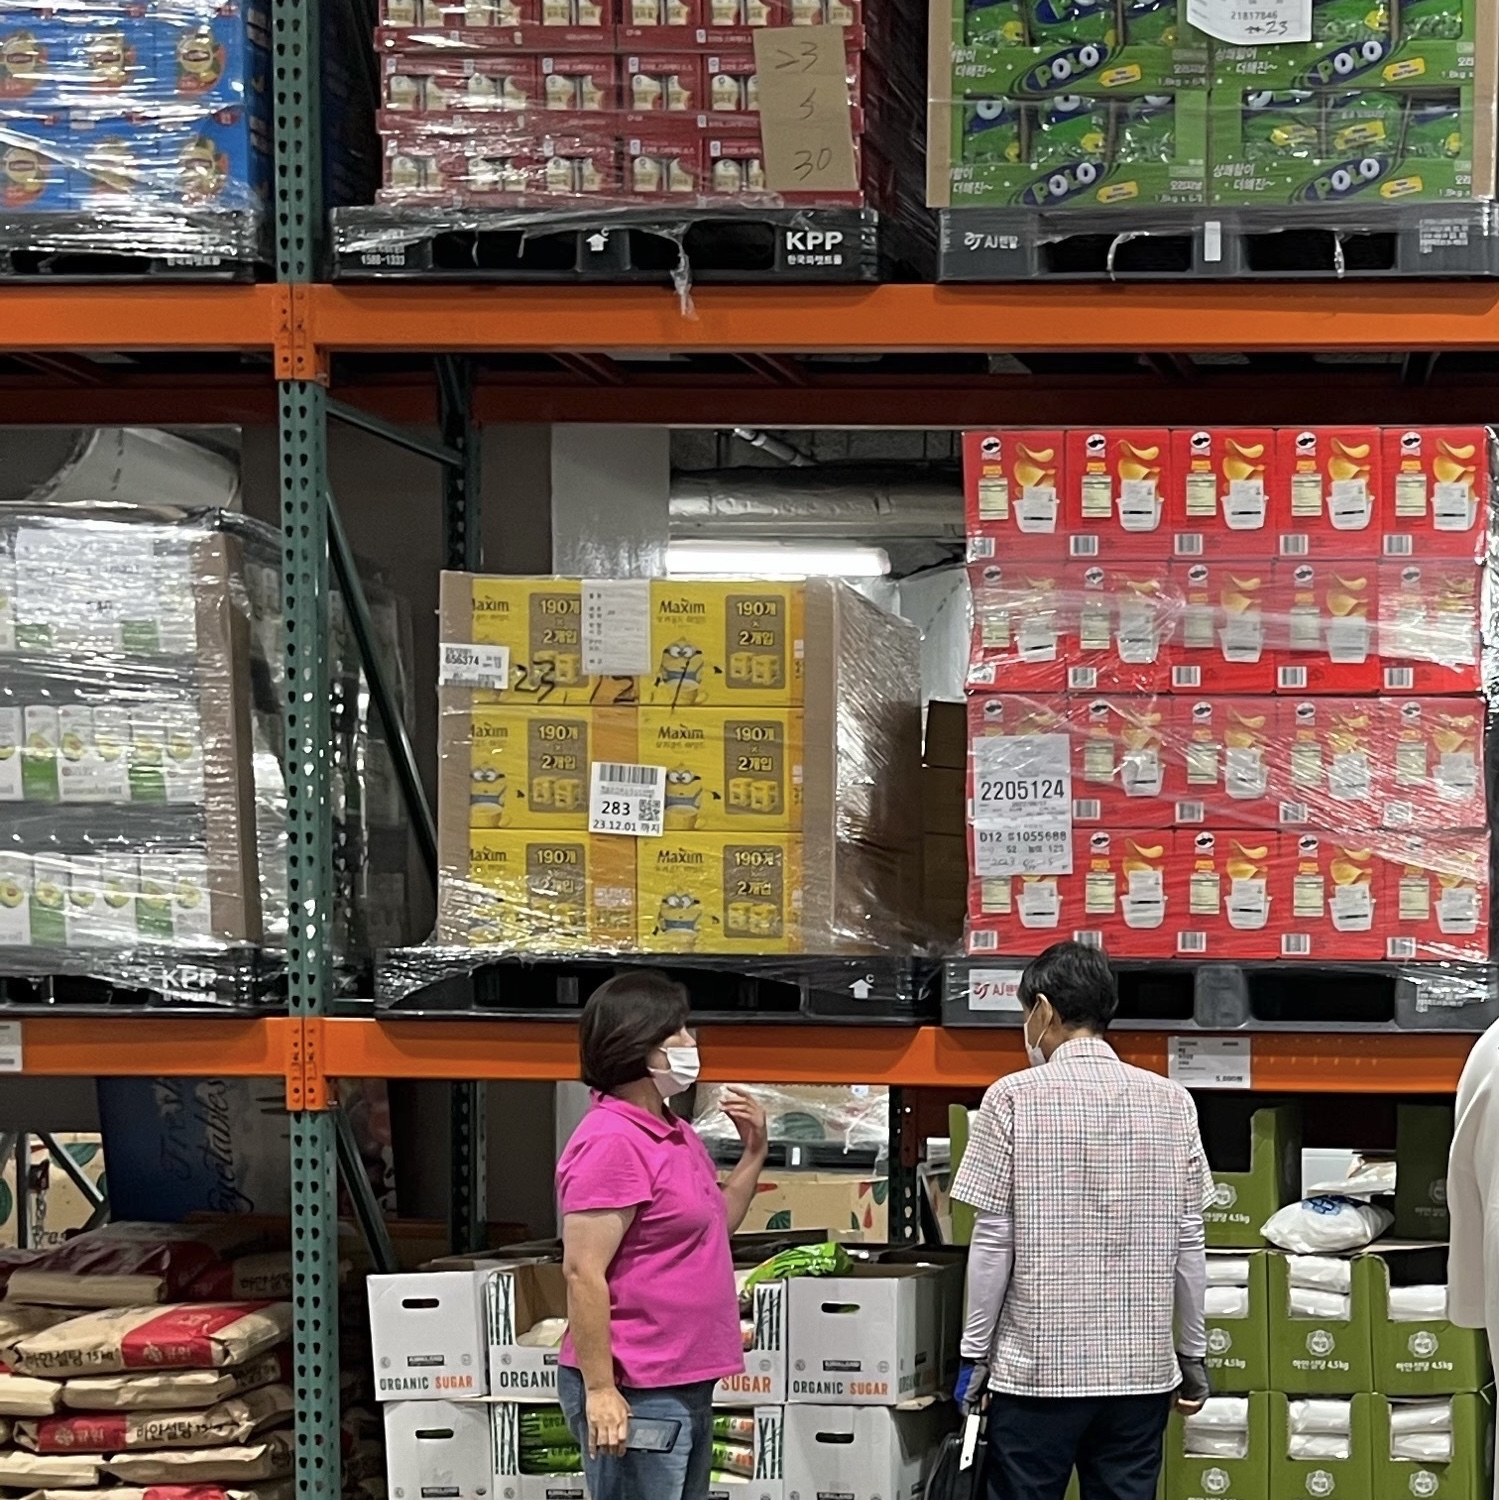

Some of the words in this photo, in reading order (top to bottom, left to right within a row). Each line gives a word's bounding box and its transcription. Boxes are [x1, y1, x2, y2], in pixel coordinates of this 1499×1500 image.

[1033, 46, 1100, 89] POLO
[1317, 40, 1383, 83] POLO
[1031, 162, 1097, 205] POLO
[1314, 158, 1380, 200] POLO
[786, 231, 843, 250] KPP
[472, 595, 509, 612] axim
[541, 600, 581, 613] 190개
[659, 598, 705, 614] Maxim
[737, 601, 776, 615] 190개
[739, 631, 774, 645] 2개입
[470, 723, 508, 738] axim
[539, 725, 578, 740] 190개
[658, 724, 704, 740] Maxim
[735, 727, 775, 741] 190개
[541, 755, 576, 770] 2개입
[738, 757, 772, 771] 2개입
[981, 779, 1064, 801] 2205124
[601, 801, 631, 816] 283
[593, 819, 636, 832] 23.12.01
[470, 846, 507, 861] axim
[537, 850, 576, 864] 190개
[657, 848, 703, 864] Maxim
[1229, 1213, 1250, 1225] 4.5kg
[1224, 1359, 1246, 1369] 4.5kg
[1327, 1359, 1349, 1371] 4.5kg
[1431, 1361, 1453, 1371] 4.5kg
[380, 1377, 429, 1391] ORGANIC
[435, 1376, 473, 1389] SUGAR
[500, 1371, 556, 1388] ORGANI
[721, 1376, 771, 1393] SUGAR
[793, 1381, 843, 1394] ORGANIC
[849, 1382, 888, 1395] SUGAR
